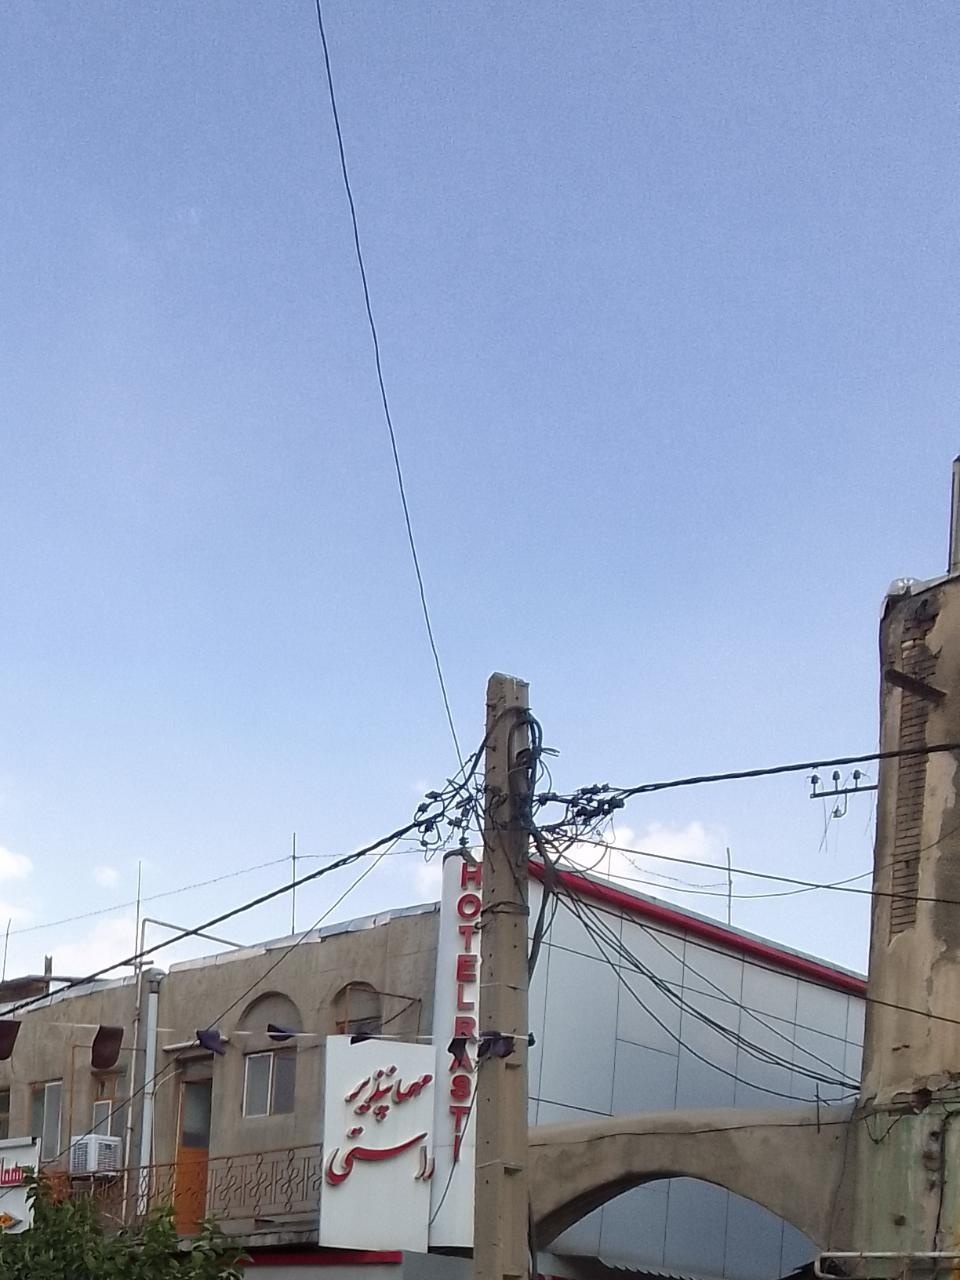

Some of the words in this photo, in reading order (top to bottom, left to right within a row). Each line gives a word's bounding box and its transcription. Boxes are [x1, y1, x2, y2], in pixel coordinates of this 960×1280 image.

[457, 862, 482, 1011] HOTEL
[345, 1065, 433, 1122] مهمانپذیر
[325, 1126, 436, 1186] راستی
